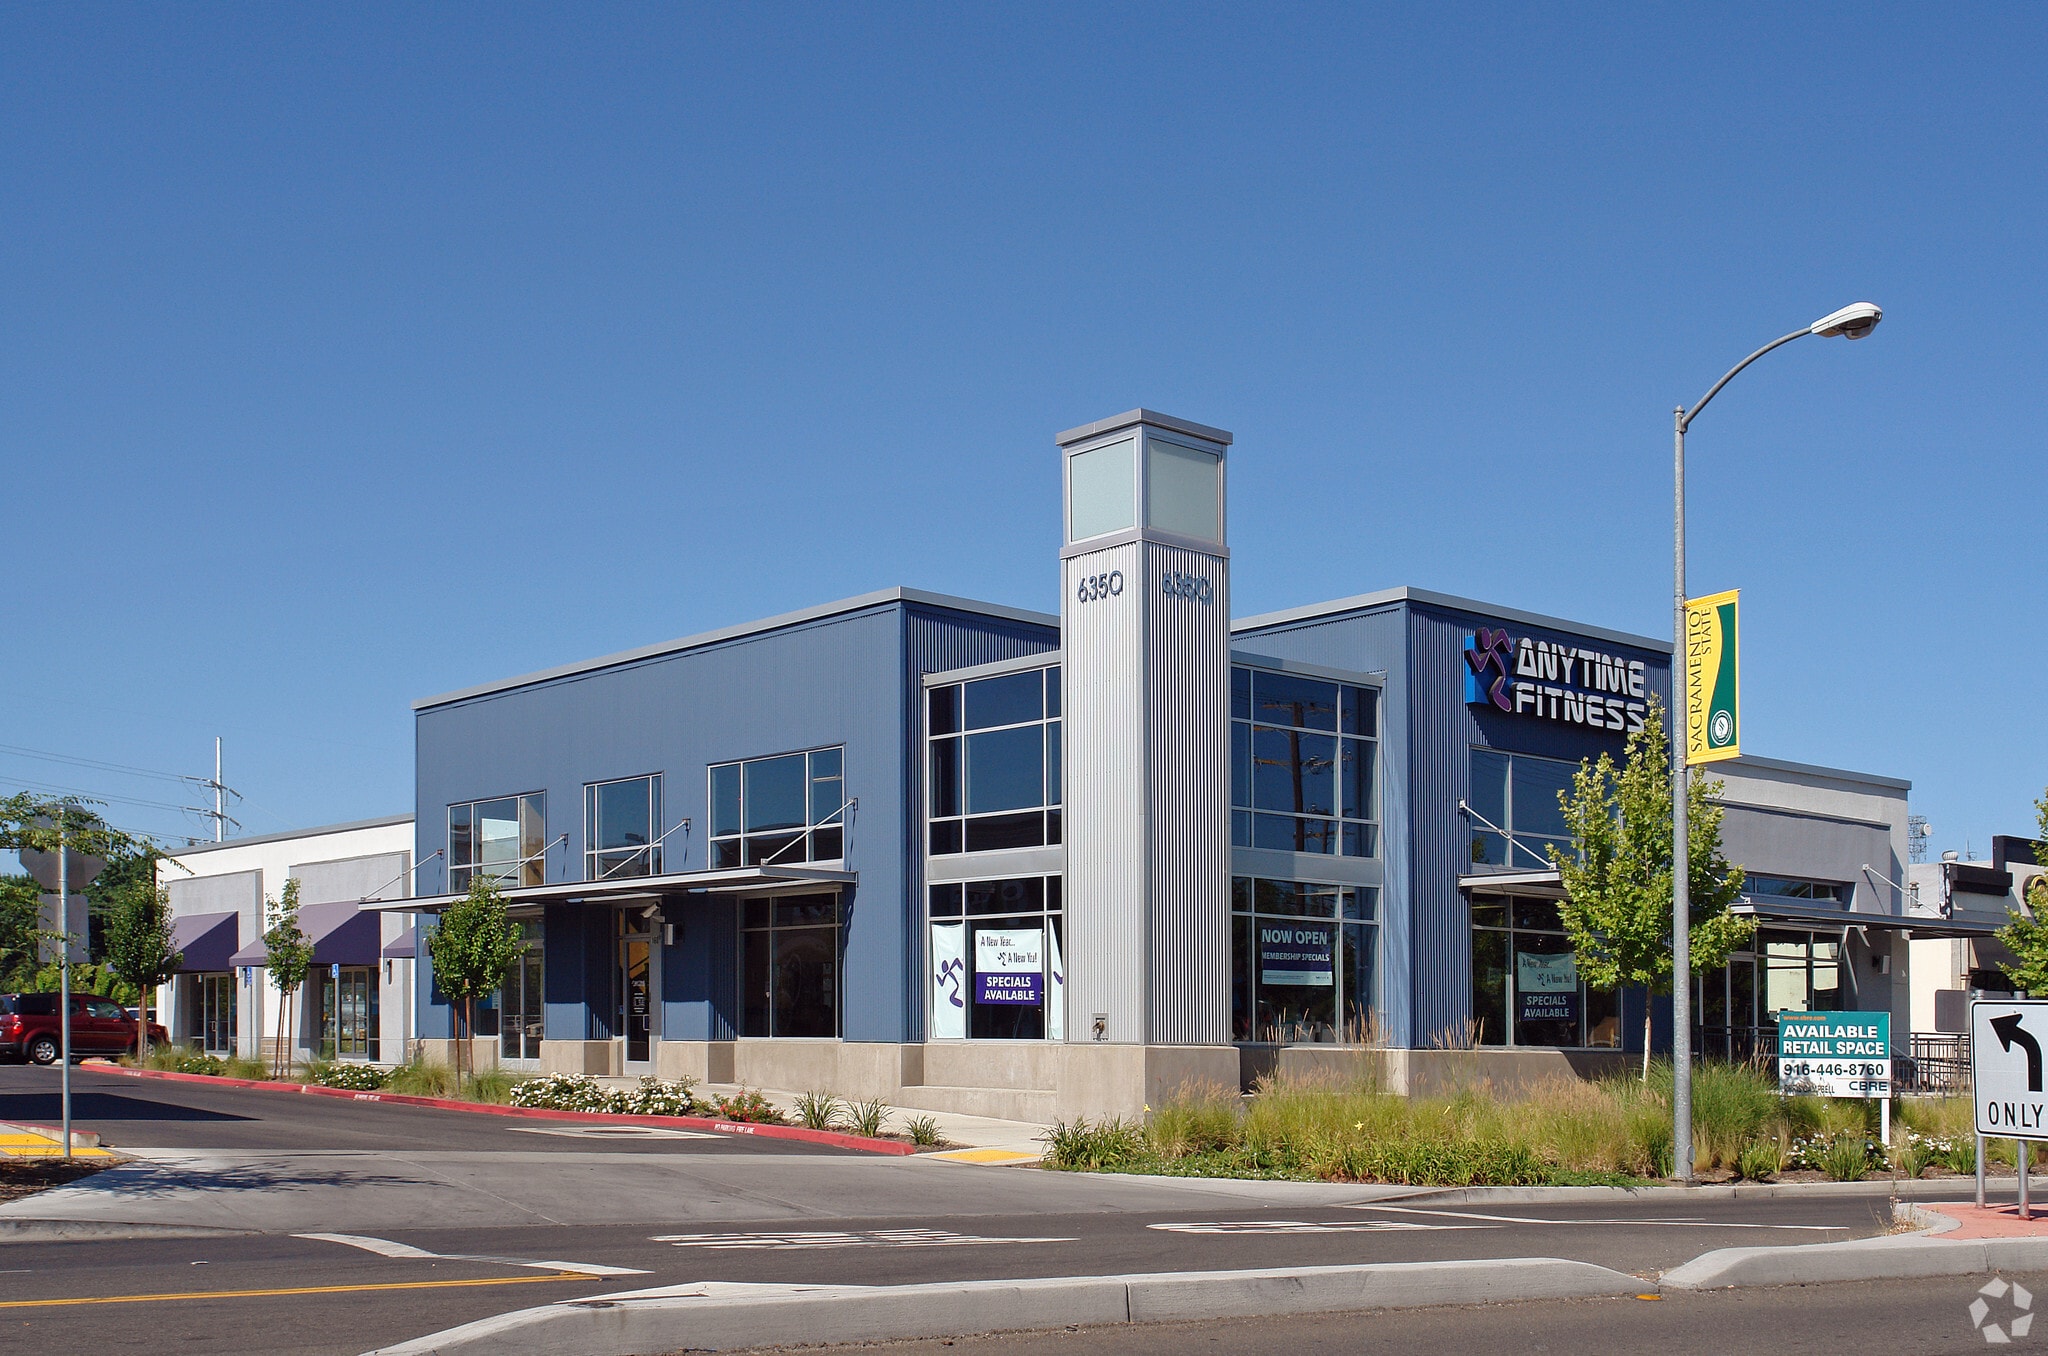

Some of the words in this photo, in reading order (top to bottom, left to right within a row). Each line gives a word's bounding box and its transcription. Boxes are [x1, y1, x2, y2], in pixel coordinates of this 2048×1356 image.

[1078, 570, 1123, 603] 6350
[1162, 570, 1213, 605] 6350
[1701, 608, 1711, 654] STATE
[1516, 637, 1645, 698] ANYTIME
[1689, 611, 1702, 752] SACRAMENTO
[1515, 681, 1645, 733] FITNESS
[981, 936, 985, 946] A
[986, 936, 998, 947] New
[1262, 929, 1292, 944] NOW
[1295, 930, 1327, 945] OPEN
[1007, 952, 1012, 963] A
[1013, 952, 1025, 963] New
[1261, 952, 1301, 961] MEMBERSHIP
[1302, 953, 1330, 962] SPECIALS
[986, 976, 1031, 987] SPECIALS
[984, 990, 1035, 1001] AVAILABLE
[1526, 995, 1567, 1006] SPECIALS
[1524, 1008, 1569, 1018] AVAILABLE
[1783, 1025, 1878, 1038] AVAILABLE
[1783, 1041, 1833, 1054] RETAIL
[1836, 1042, 1885, 1055] SPACE
[1783, 1063, 1884, 1076] 916-446-8760
[1849, 1081, 1888, 1092] CBRE
[1988, 1101, 2044, 1128] ONLY
